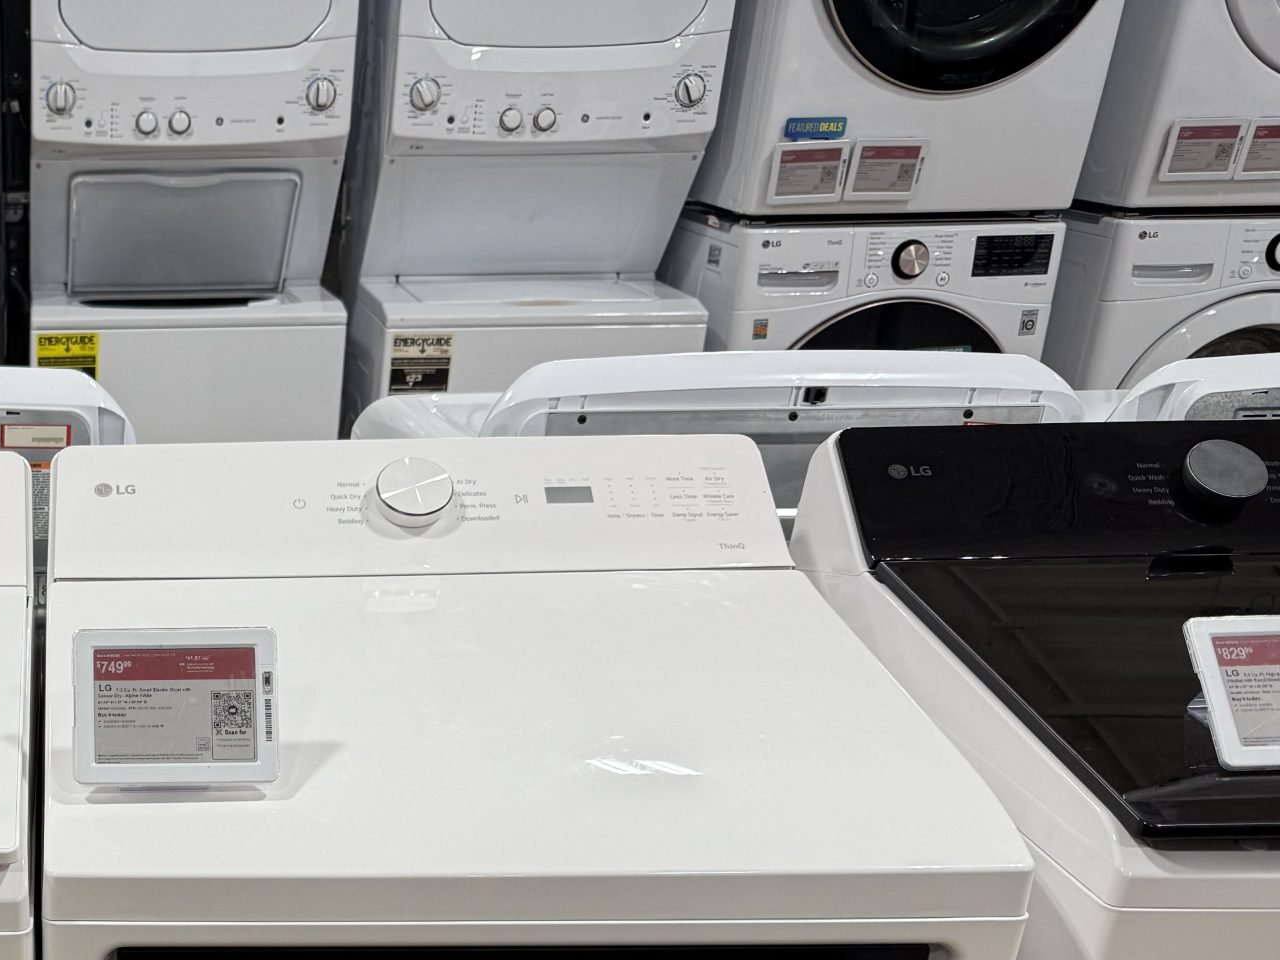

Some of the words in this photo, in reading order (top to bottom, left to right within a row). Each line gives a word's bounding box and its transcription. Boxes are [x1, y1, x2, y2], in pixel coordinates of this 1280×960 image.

[787, 122, 820, 132] FEATURED
[820, 122, 844, 131] DEALS
[1148, 231, 1158, 239] LG
[771, 240, 782, 248] LG
[909, 465, 933, 476] LG
[116, 484, 137, 495] LG
[1153, 486, 1169, 494] Duty
[718, 542, 745, 550] ThinQ
[1225, 669, 1240, 678] LG
[98, 684, 112, 692] LG
